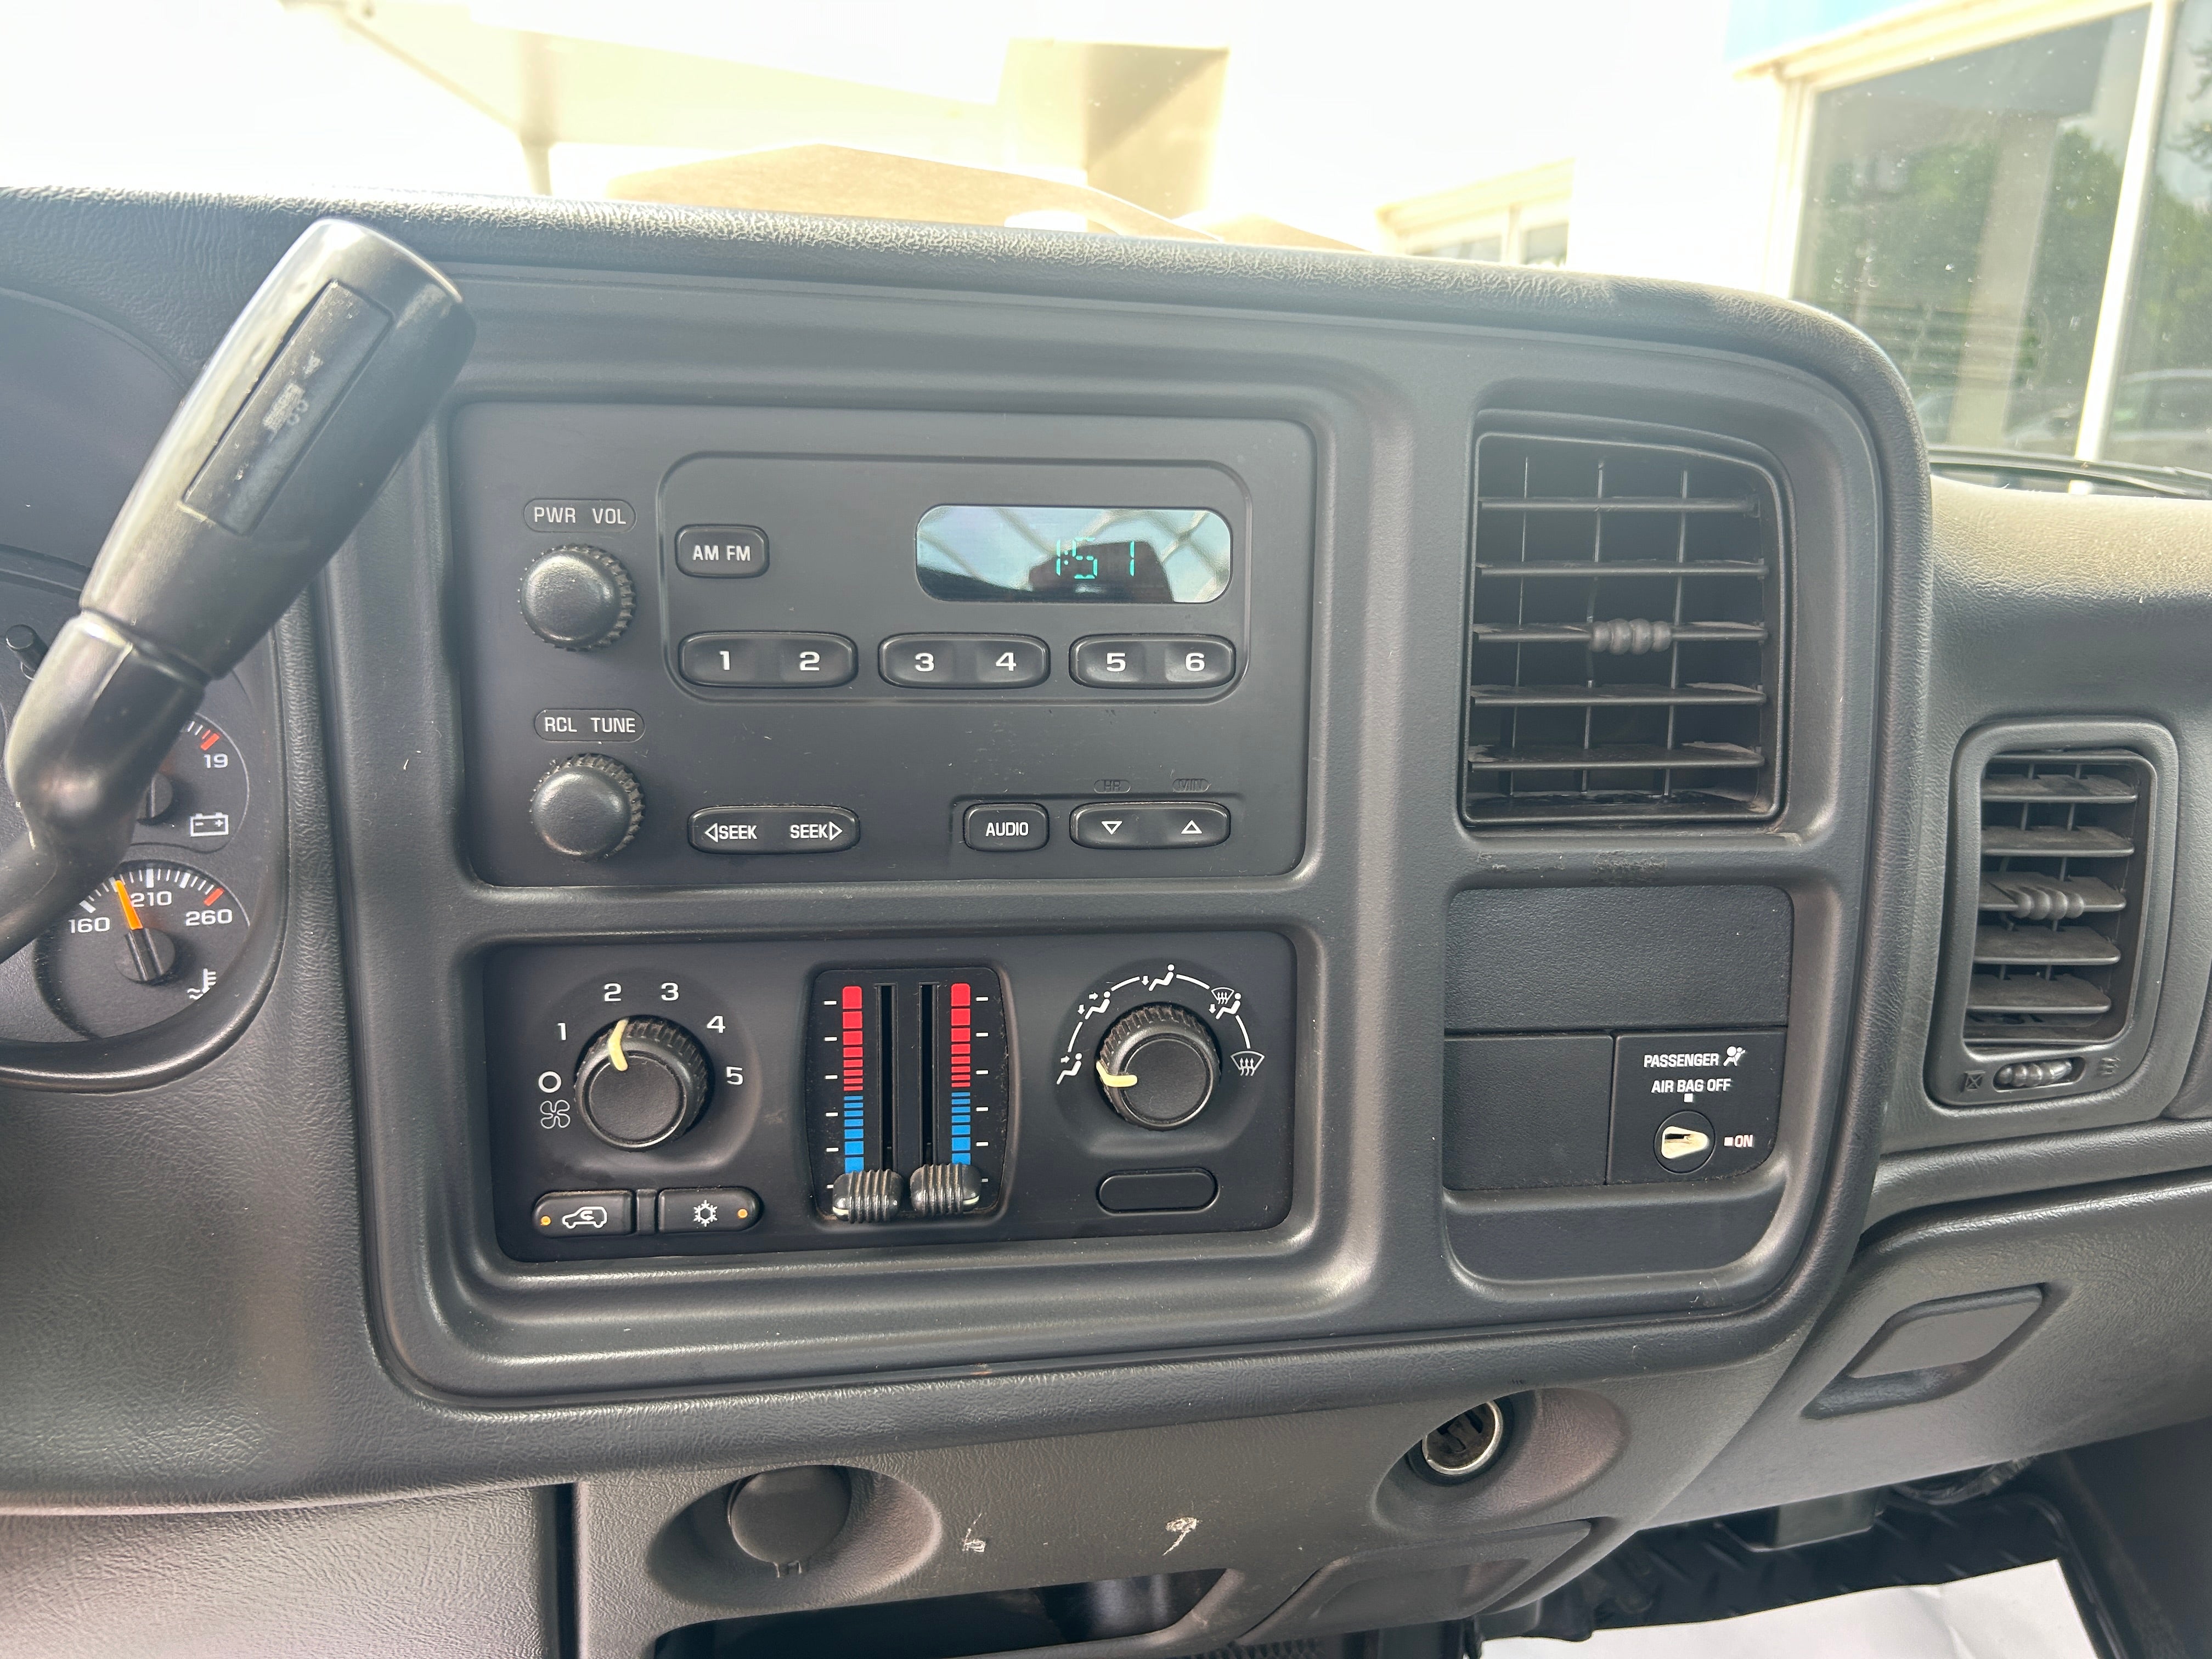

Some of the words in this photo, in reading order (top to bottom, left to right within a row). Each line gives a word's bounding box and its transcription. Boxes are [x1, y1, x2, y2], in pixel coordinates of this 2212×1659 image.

[533, 507, 577, 524] PWR
[591, 508, 627, 525] VOL
[692, 545, 720, 561] AM
[726, 545, 751, 562] FM
[719, 651, 731, 671] 1
[799, 651, 821, 672] 2
[915, 652, 935, 672] 3
[995, 652, 1017, 672] 4
[1105, 653, 1126, 672] 5
[1185, 653, 1205, 672] 6
[544, 716, 578, 733] RCL
[590, 717, 636, 733] TUNE
[204, 753, 229, 769] 19
[719, 824, 758, 840] SEEK
[789, 823, 828, 839] SEEK
[985, 821, 1029, 837] AUDIO
[130, 890, 173, 907] 210
[69, 917, 111, 934] 160
[185, 909, 233, 927] 260
[603, 983, 622, 1002] 2
[661, 982, 680, 1002] 3
[557, 1022, 567, 1041] 1
[707, 1015, 726, 1034] 4
[1643, 1053, 1720, 1068] PASSENGER
[726, 1066, 744, 1086] 5
[1651, 1080, 1674, 1093] AIR
[1677, 1079, 1705, 1092] BAG
[1707, 1078, 1732, 1092] OFF
[1734, 1135, 1753, 1148] ON
